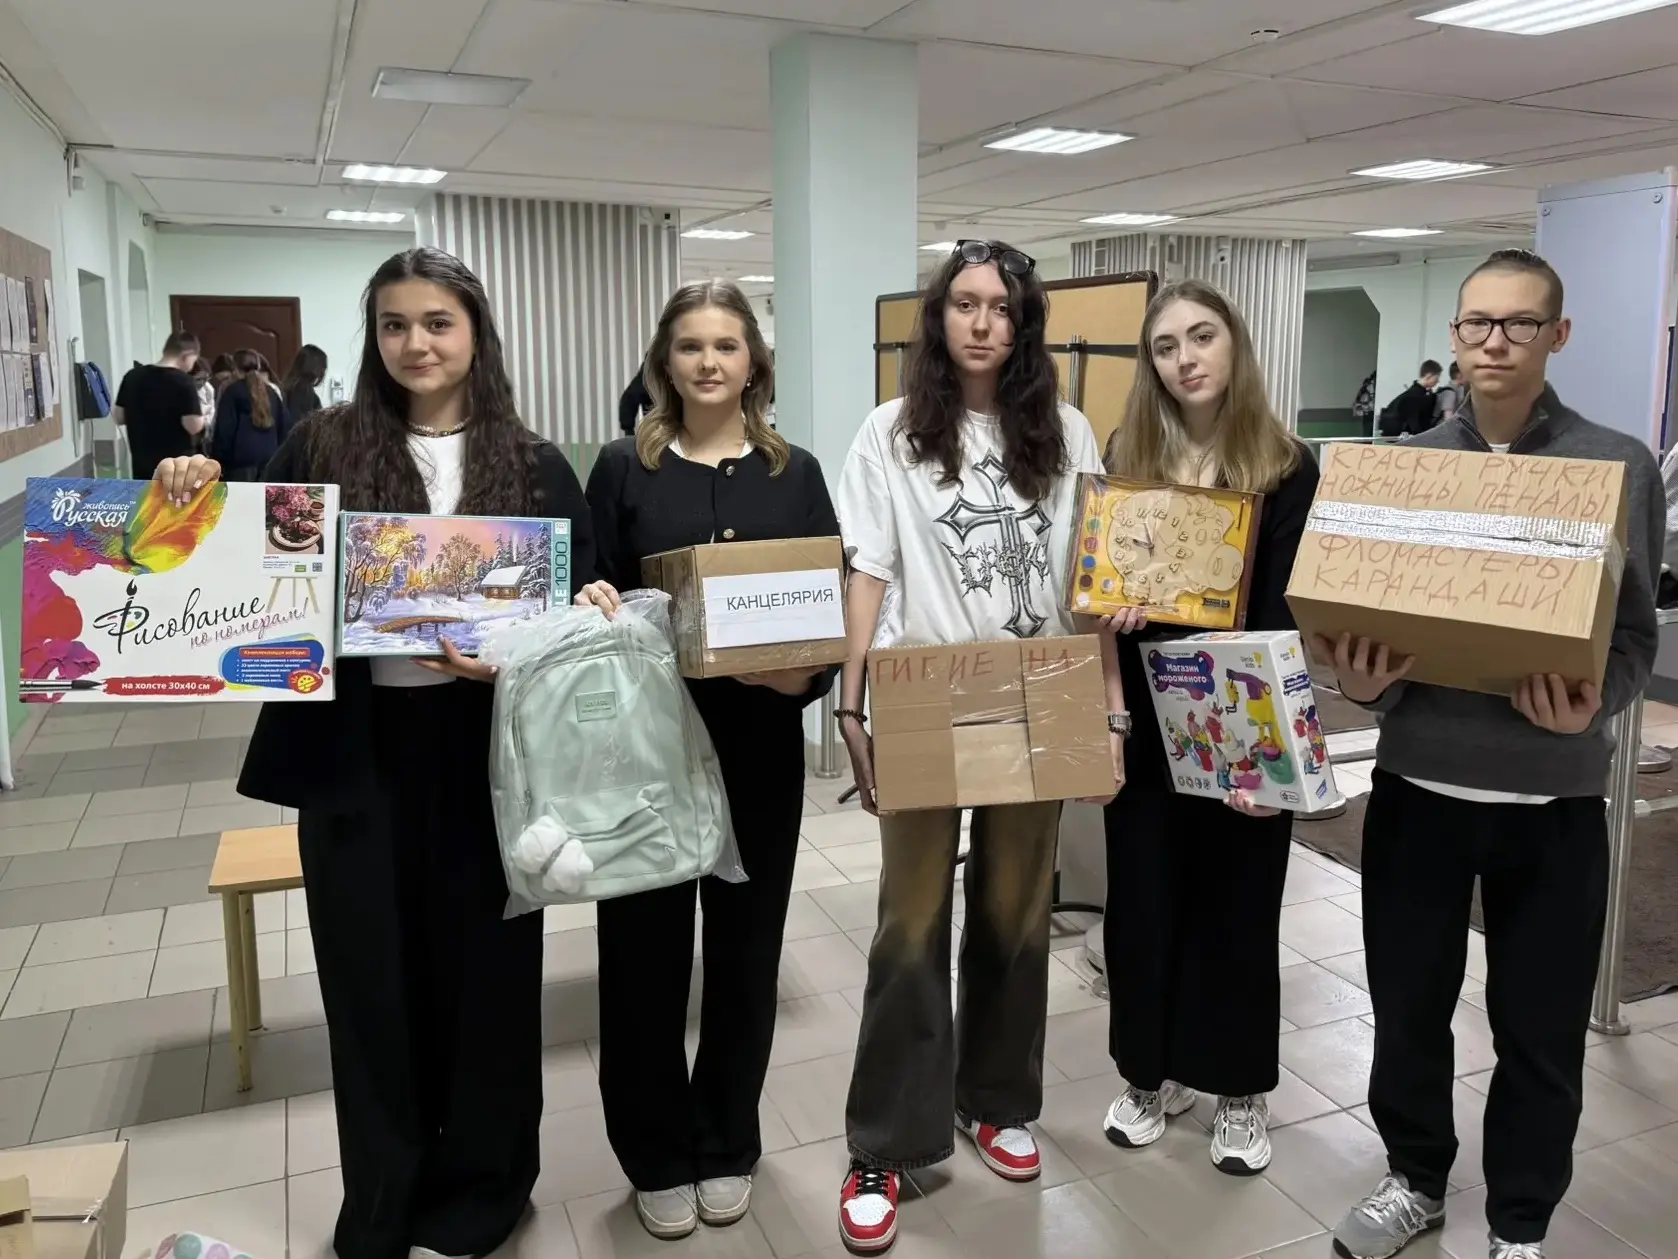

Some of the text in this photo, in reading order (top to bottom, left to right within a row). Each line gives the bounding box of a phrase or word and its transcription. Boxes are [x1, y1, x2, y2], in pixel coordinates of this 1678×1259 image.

[1331, 446, 1612, 488] КРАСКИ РУЧКИ
[52, 495, 129, 528] Русская
[82, 500, 130, 511] живопись
[1318, 473, 1610, 523] НОЖНИЦЫ ПЕНАЛЫ
[555, 541, 567, 586] 1000
[1319, 534, 1579, 589] ФЛОМАСТЕРЫ
[726, 588, 834, 610] КАНЦЕЛЯРИЯ
[1313, 564, 1562, 616] КАРАНДАШИ
[93, 579, 265, 654] Рисование
[168, 682, 196, 690] 30х40
[1157, 674, 1208, 684] мороженого
[1165, 663, 1200, 673] Магазин
